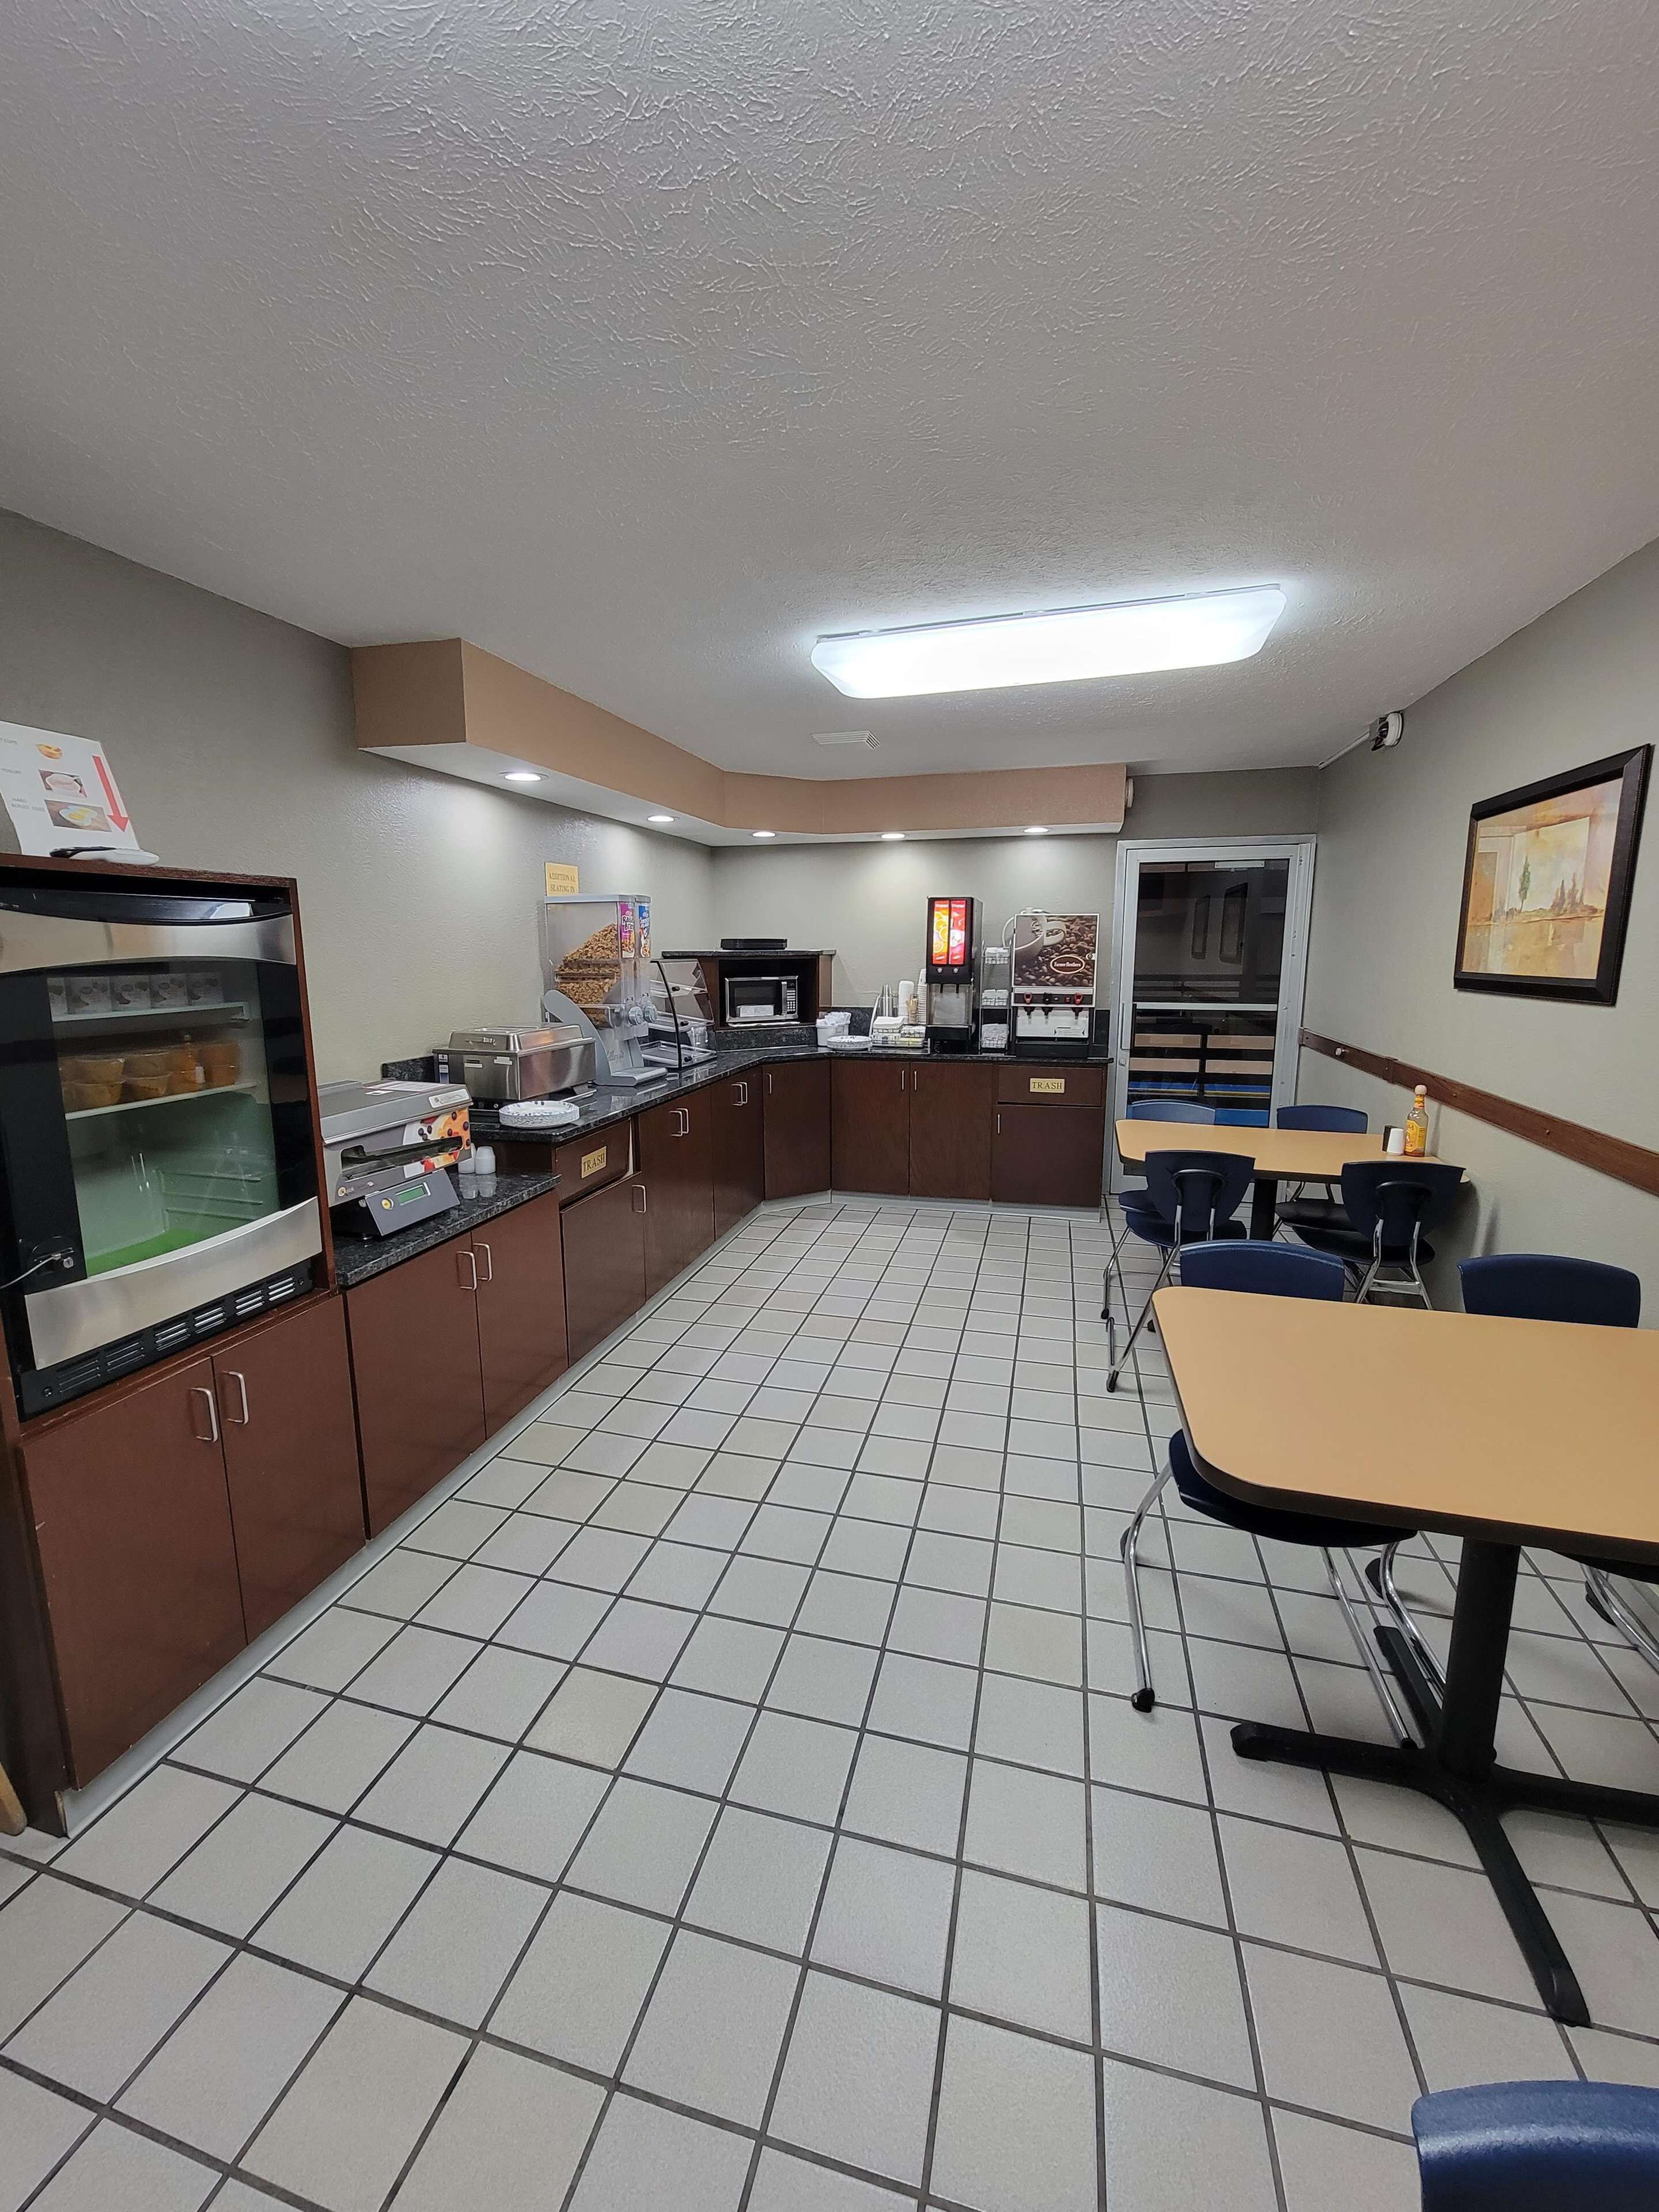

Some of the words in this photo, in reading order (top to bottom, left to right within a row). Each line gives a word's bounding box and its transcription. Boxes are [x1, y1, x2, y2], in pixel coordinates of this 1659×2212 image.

[549, 872, 575, 882] ADDITIONAL
[550, 884, 570, 893] SEATING
[1032, 1081, 1062, 1090] TRASH
[583, 1153, 605, 1172] TRASH
